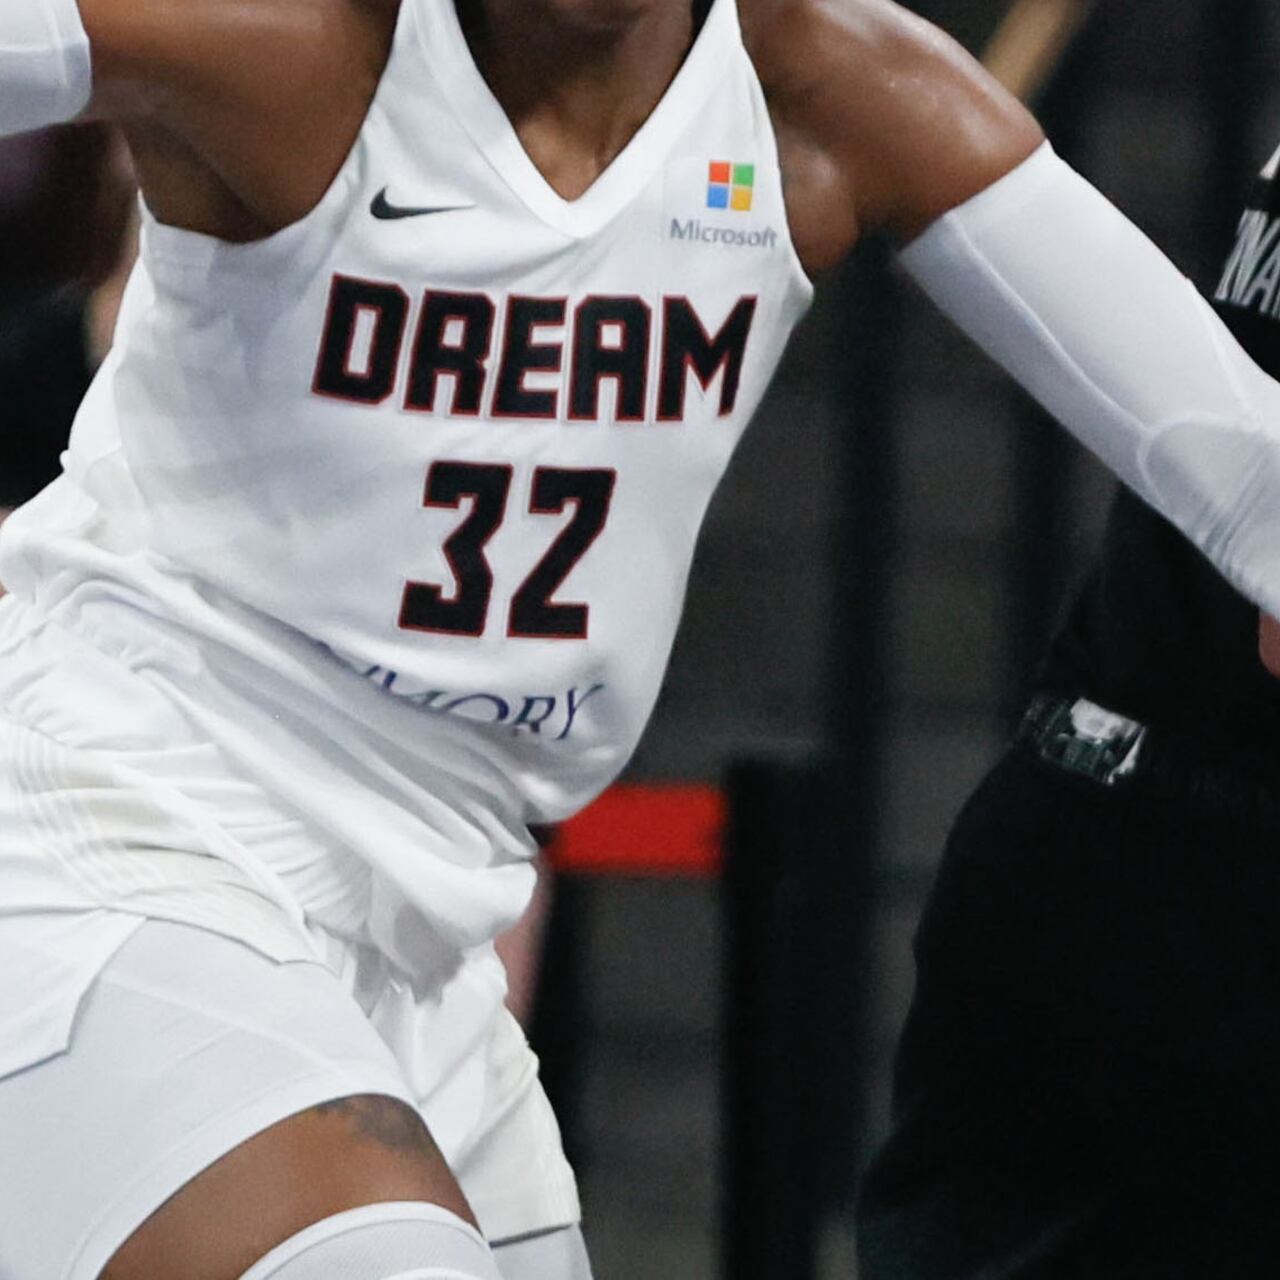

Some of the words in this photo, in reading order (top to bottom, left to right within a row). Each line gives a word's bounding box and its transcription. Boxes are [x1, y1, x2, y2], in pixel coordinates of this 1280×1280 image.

[670, 218, 778, 248] Microsoft
[311, 272, 758, 422] DREAM
[398, 460, 617, 639] 32
